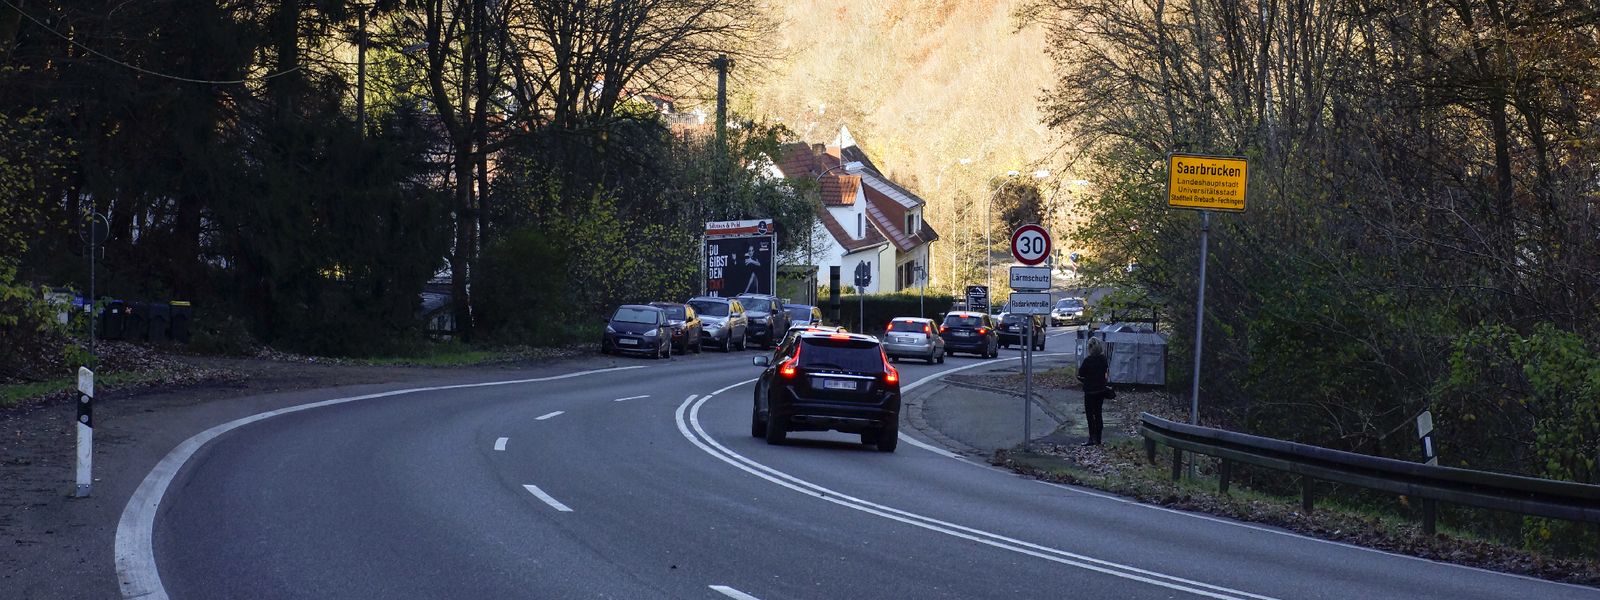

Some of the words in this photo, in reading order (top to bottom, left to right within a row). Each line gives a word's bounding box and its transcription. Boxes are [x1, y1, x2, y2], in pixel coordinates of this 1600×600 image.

[1177, 161, 1241, 177] Saarbrücken
[1177, 178, 1239, 188] Landeshauptstadt
[1178, 187, 1237, 196] Universitätsstadt
[1171, 194, 1193, 202] Stadtteil
[1193, 196, 1244, 206] Brebach-Fechingen
[709, 244, 719, 256] DU
[1020, 236, 1043, 255] 30
[709, 255, 728, 267] GIBST
[709, 268, 723, 279] DEN
[1011, 273, 1049, 283] Lärmschutz
[1011, 299, 1049, 309] Radarkontrolle
